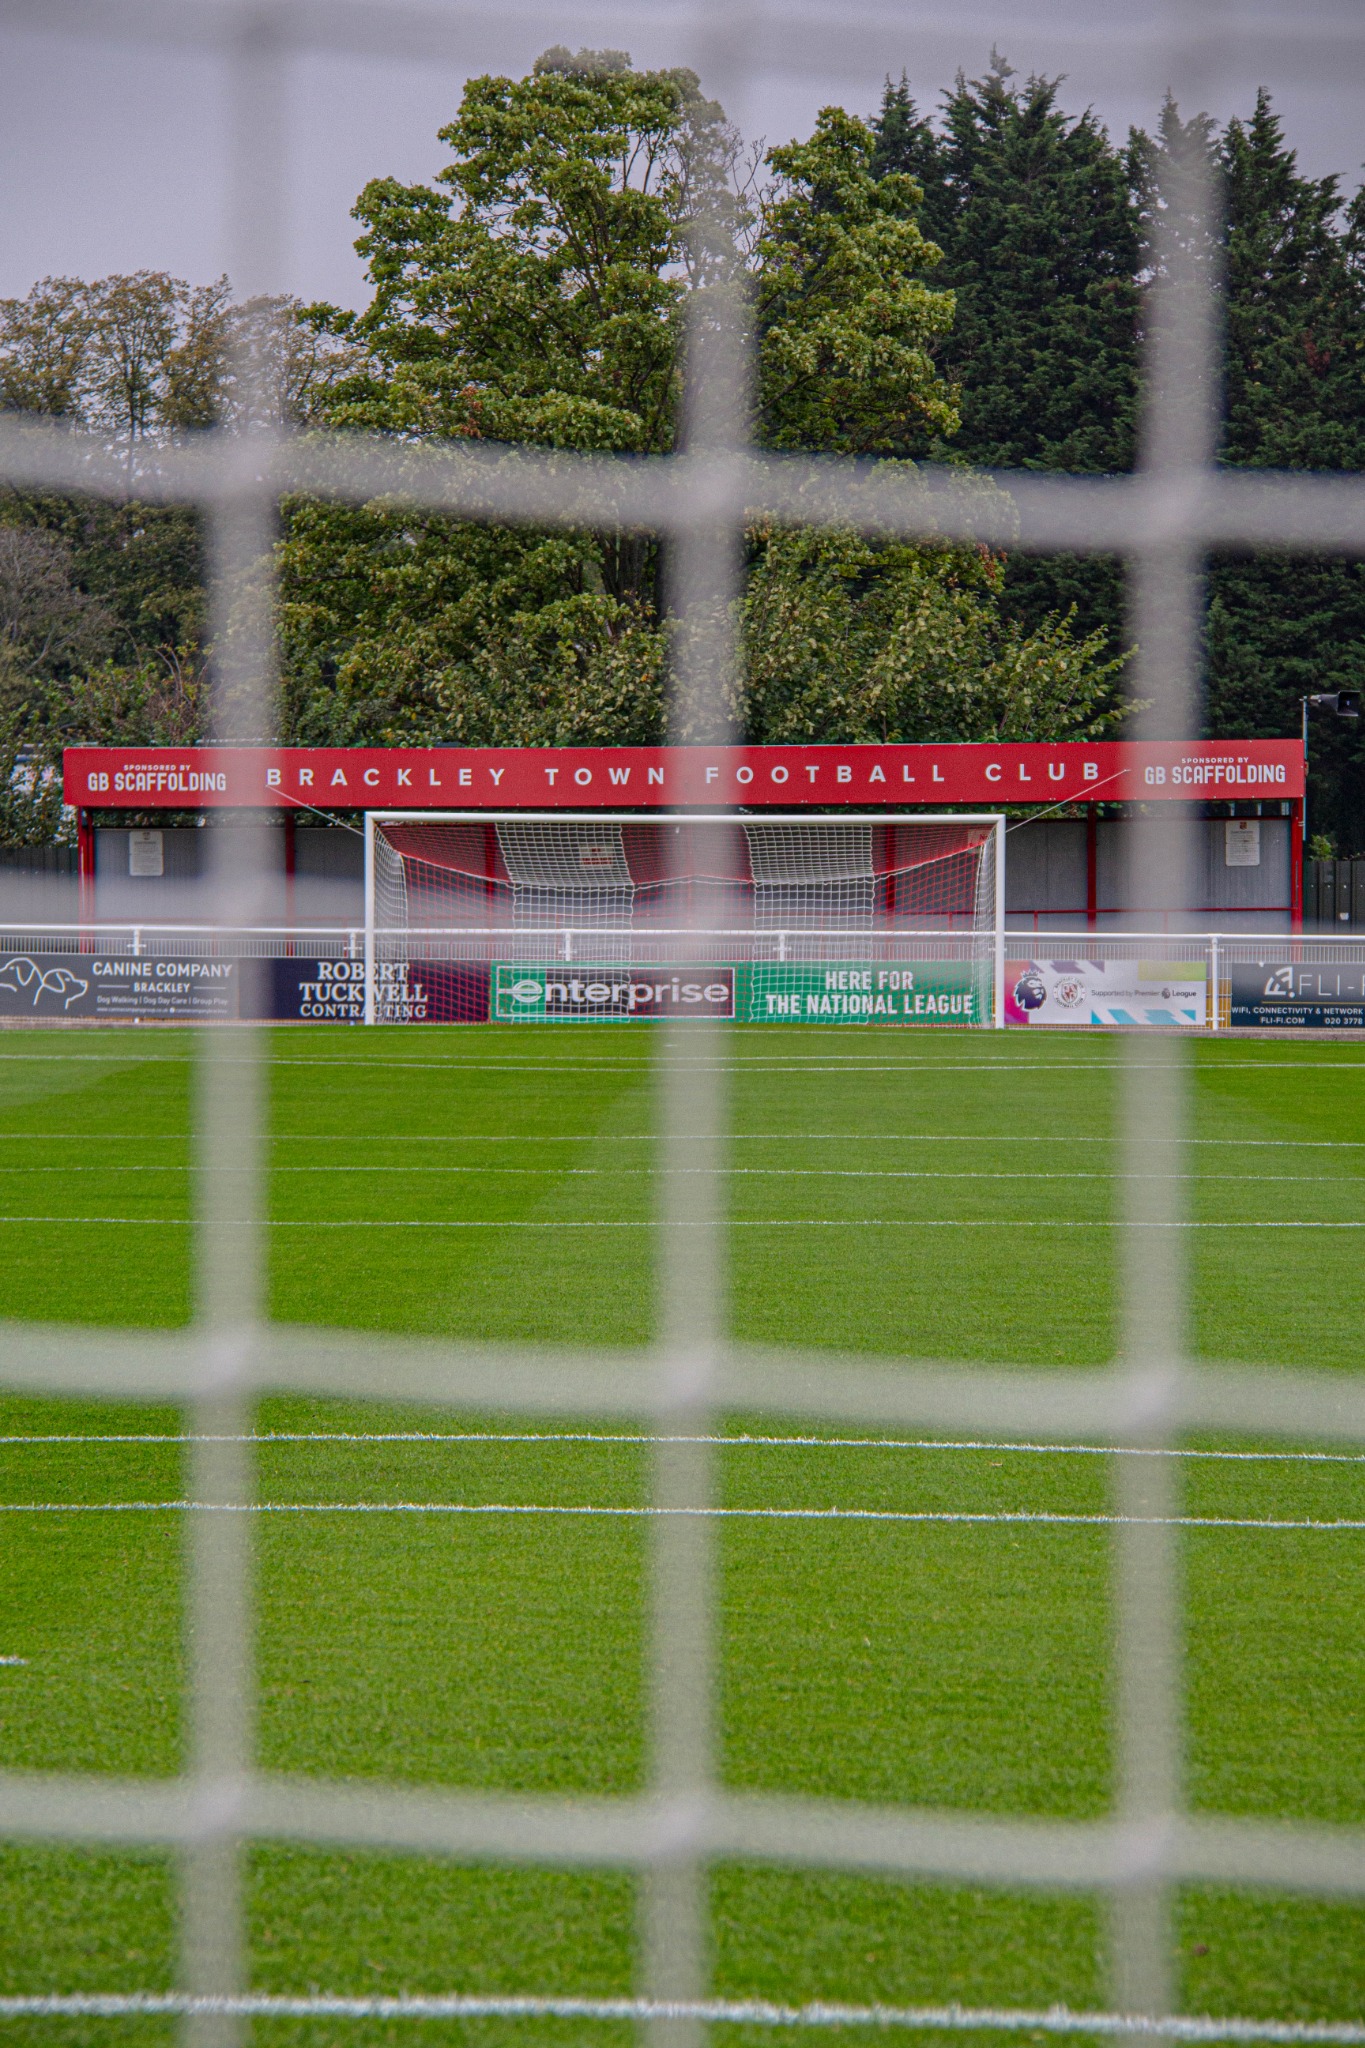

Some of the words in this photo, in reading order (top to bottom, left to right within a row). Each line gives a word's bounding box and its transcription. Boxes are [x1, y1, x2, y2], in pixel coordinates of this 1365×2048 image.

[87, 772, 109, 792] GB
[114, 772, 226, 792] SCAFFOLDING
[266, 768, 504, 786] BRACKLEY
[545, 767, 665, 786] TOWN
[706, 765, 944, 785] FOOTBALL
[985, 762, 1100, 782] CLUB
[1144, 766, 1166, 785] GB
[1171, 764, 1286, 784] SCAFFOLDING
[92, 962, 152, 976] CANINE
[155, 962, 233, 978] COMPANY
[133, 982, 191, 993] BRACKLEY
[825, 971, 871, 990] HERE
[879, 971, 914, 990] FOR
[498, 977, 729, 1010] enterprise
[1091, 989, 1124, 997] Supported
[1172, 989, 1197, 997] League
[766, 995, 800, 1014] THE
[807, 995, 898, 1014] NATIONAL
[904, 995, 973, 1014] LEAGUE
[1231, 1006, 1251, 1014] WIFI,
[1323, 1007, 1363, 1015] NETWORK
[1260, 1016, 1305, 1025] FLI-FI.COM
[1324, 1017, 1341, 1025] 020
